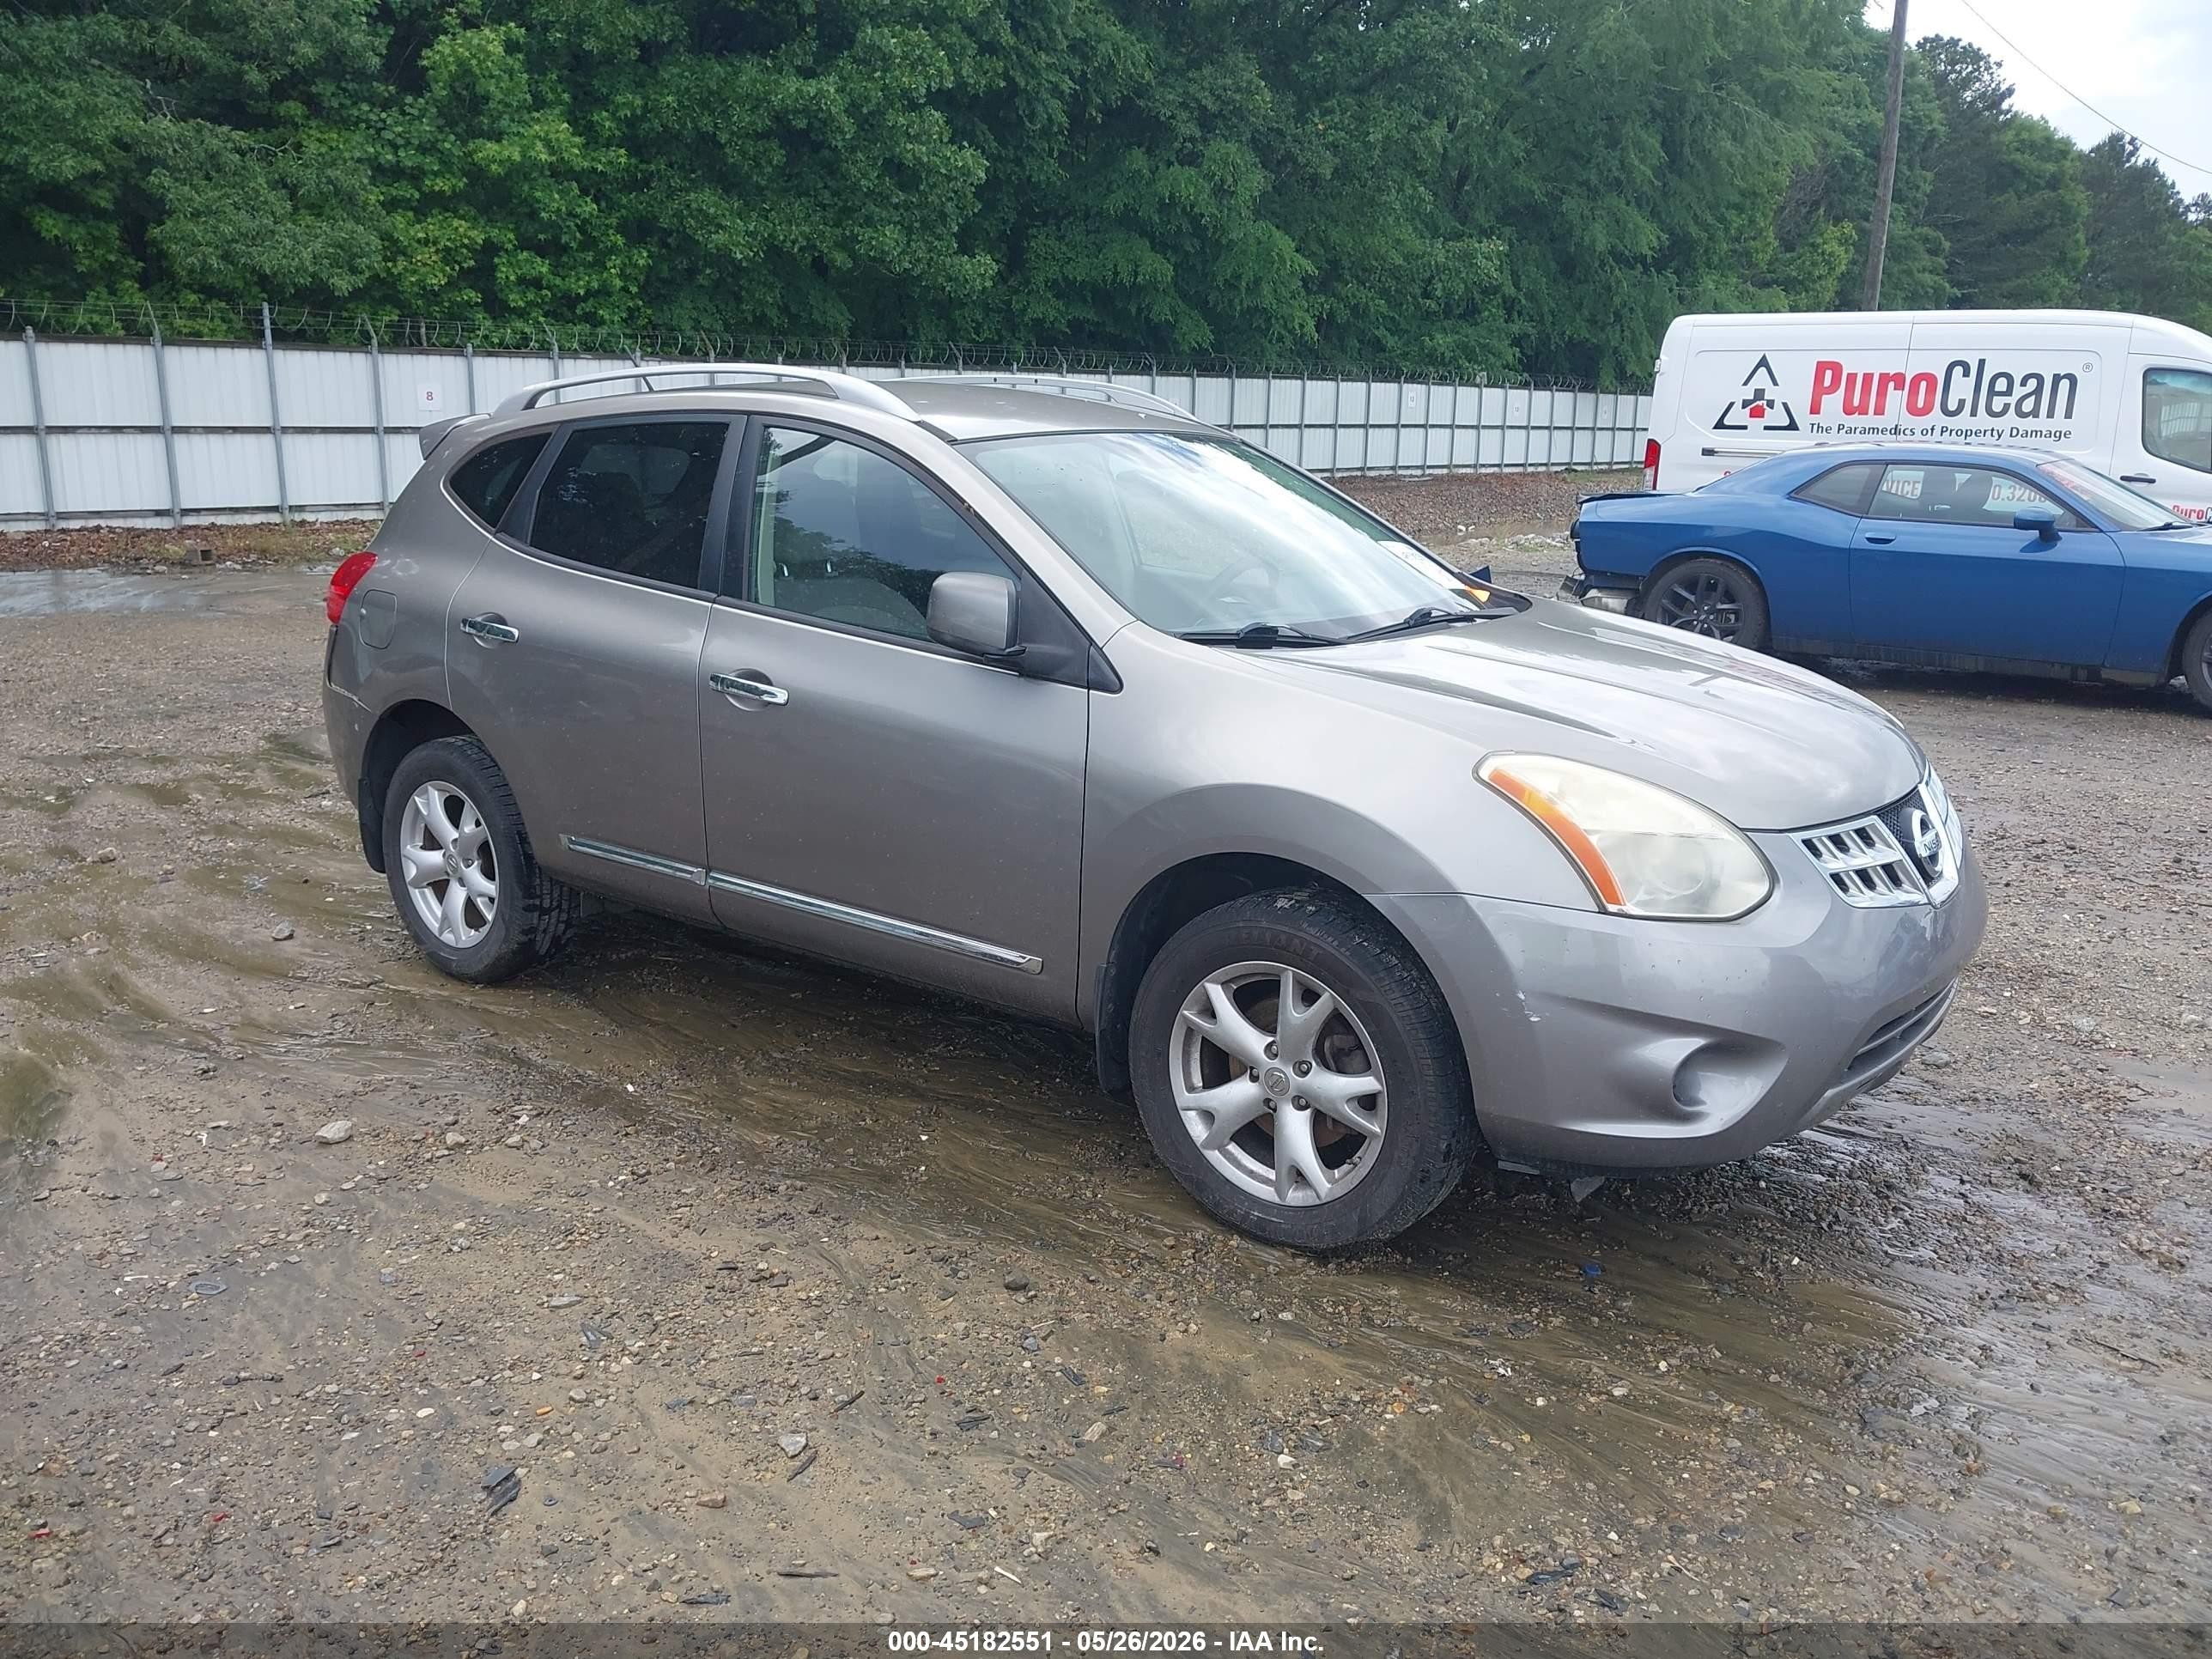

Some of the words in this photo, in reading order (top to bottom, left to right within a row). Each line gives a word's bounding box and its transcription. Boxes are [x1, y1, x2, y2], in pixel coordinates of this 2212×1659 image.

[426, 391, 434, 401] 8
[1808, 358, 2078, 420] PuroClean
[1809, 422, 1832, 434] The
[1837, 423, 1916, 436] Paramedics
[1920, 424, 1936, 436] of
[1940, 425, 2005, 441] Property
[2009, 427, 2072, 441] Damage
